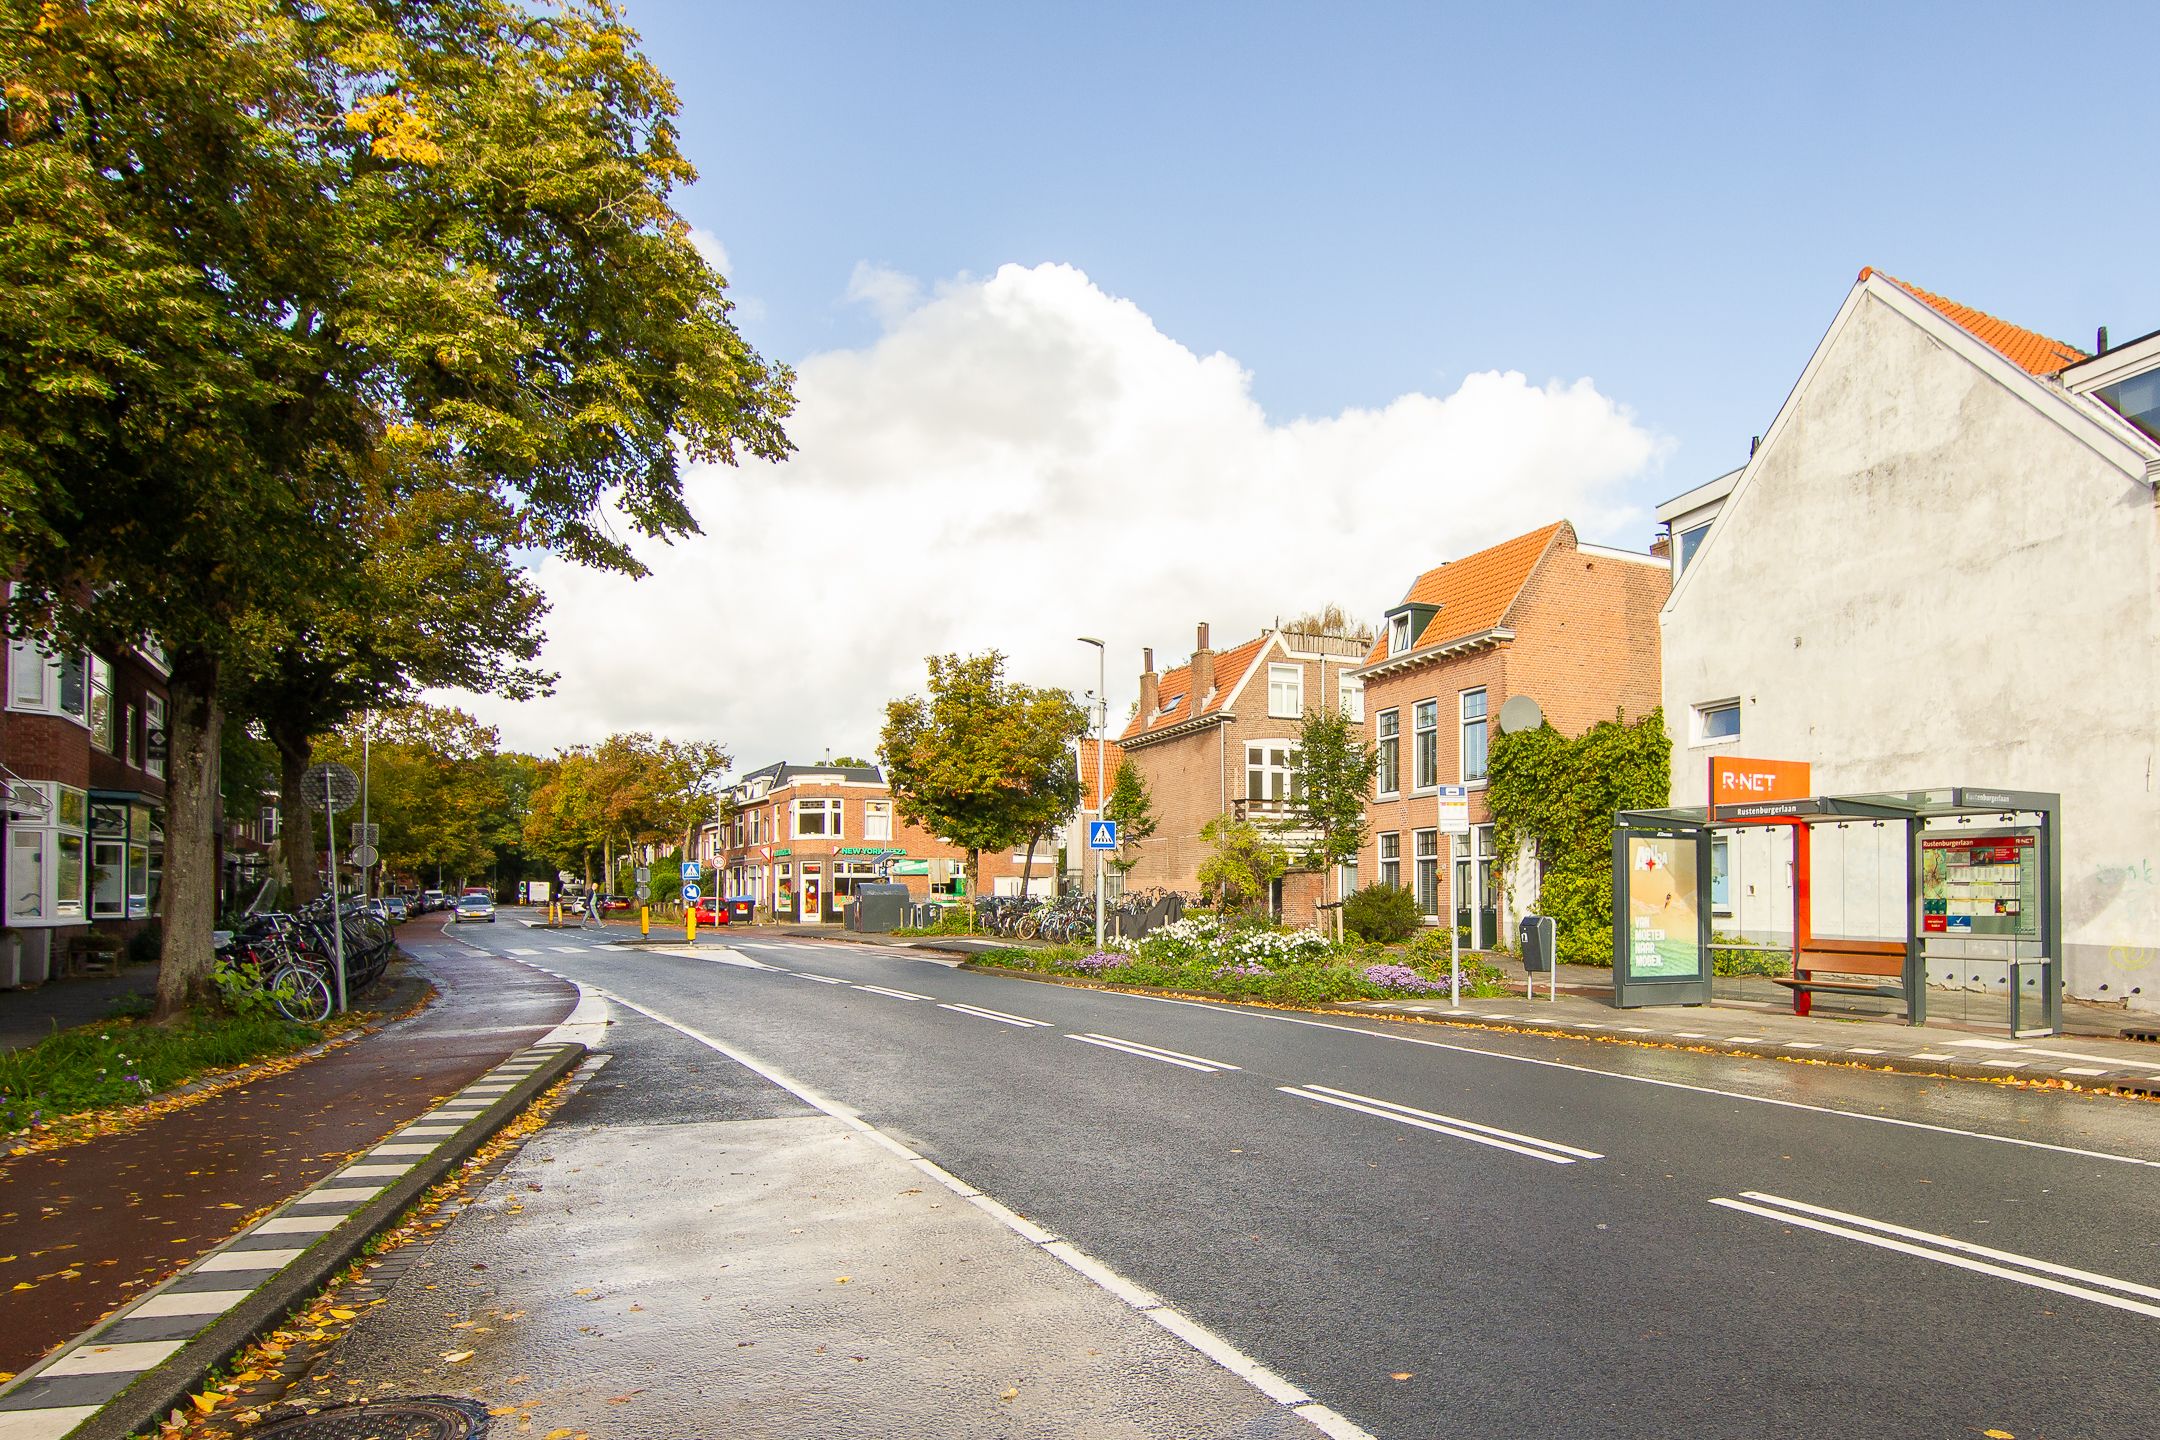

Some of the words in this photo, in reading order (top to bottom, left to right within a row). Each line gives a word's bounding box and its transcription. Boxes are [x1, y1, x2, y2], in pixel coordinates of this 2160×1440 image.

[1737, 805, 1797, 816] Rustenburgerlaan
[1923, 840, 1974, 848] Rustenburgerlaan
[1635, 942, 1656, 955] NAAR
